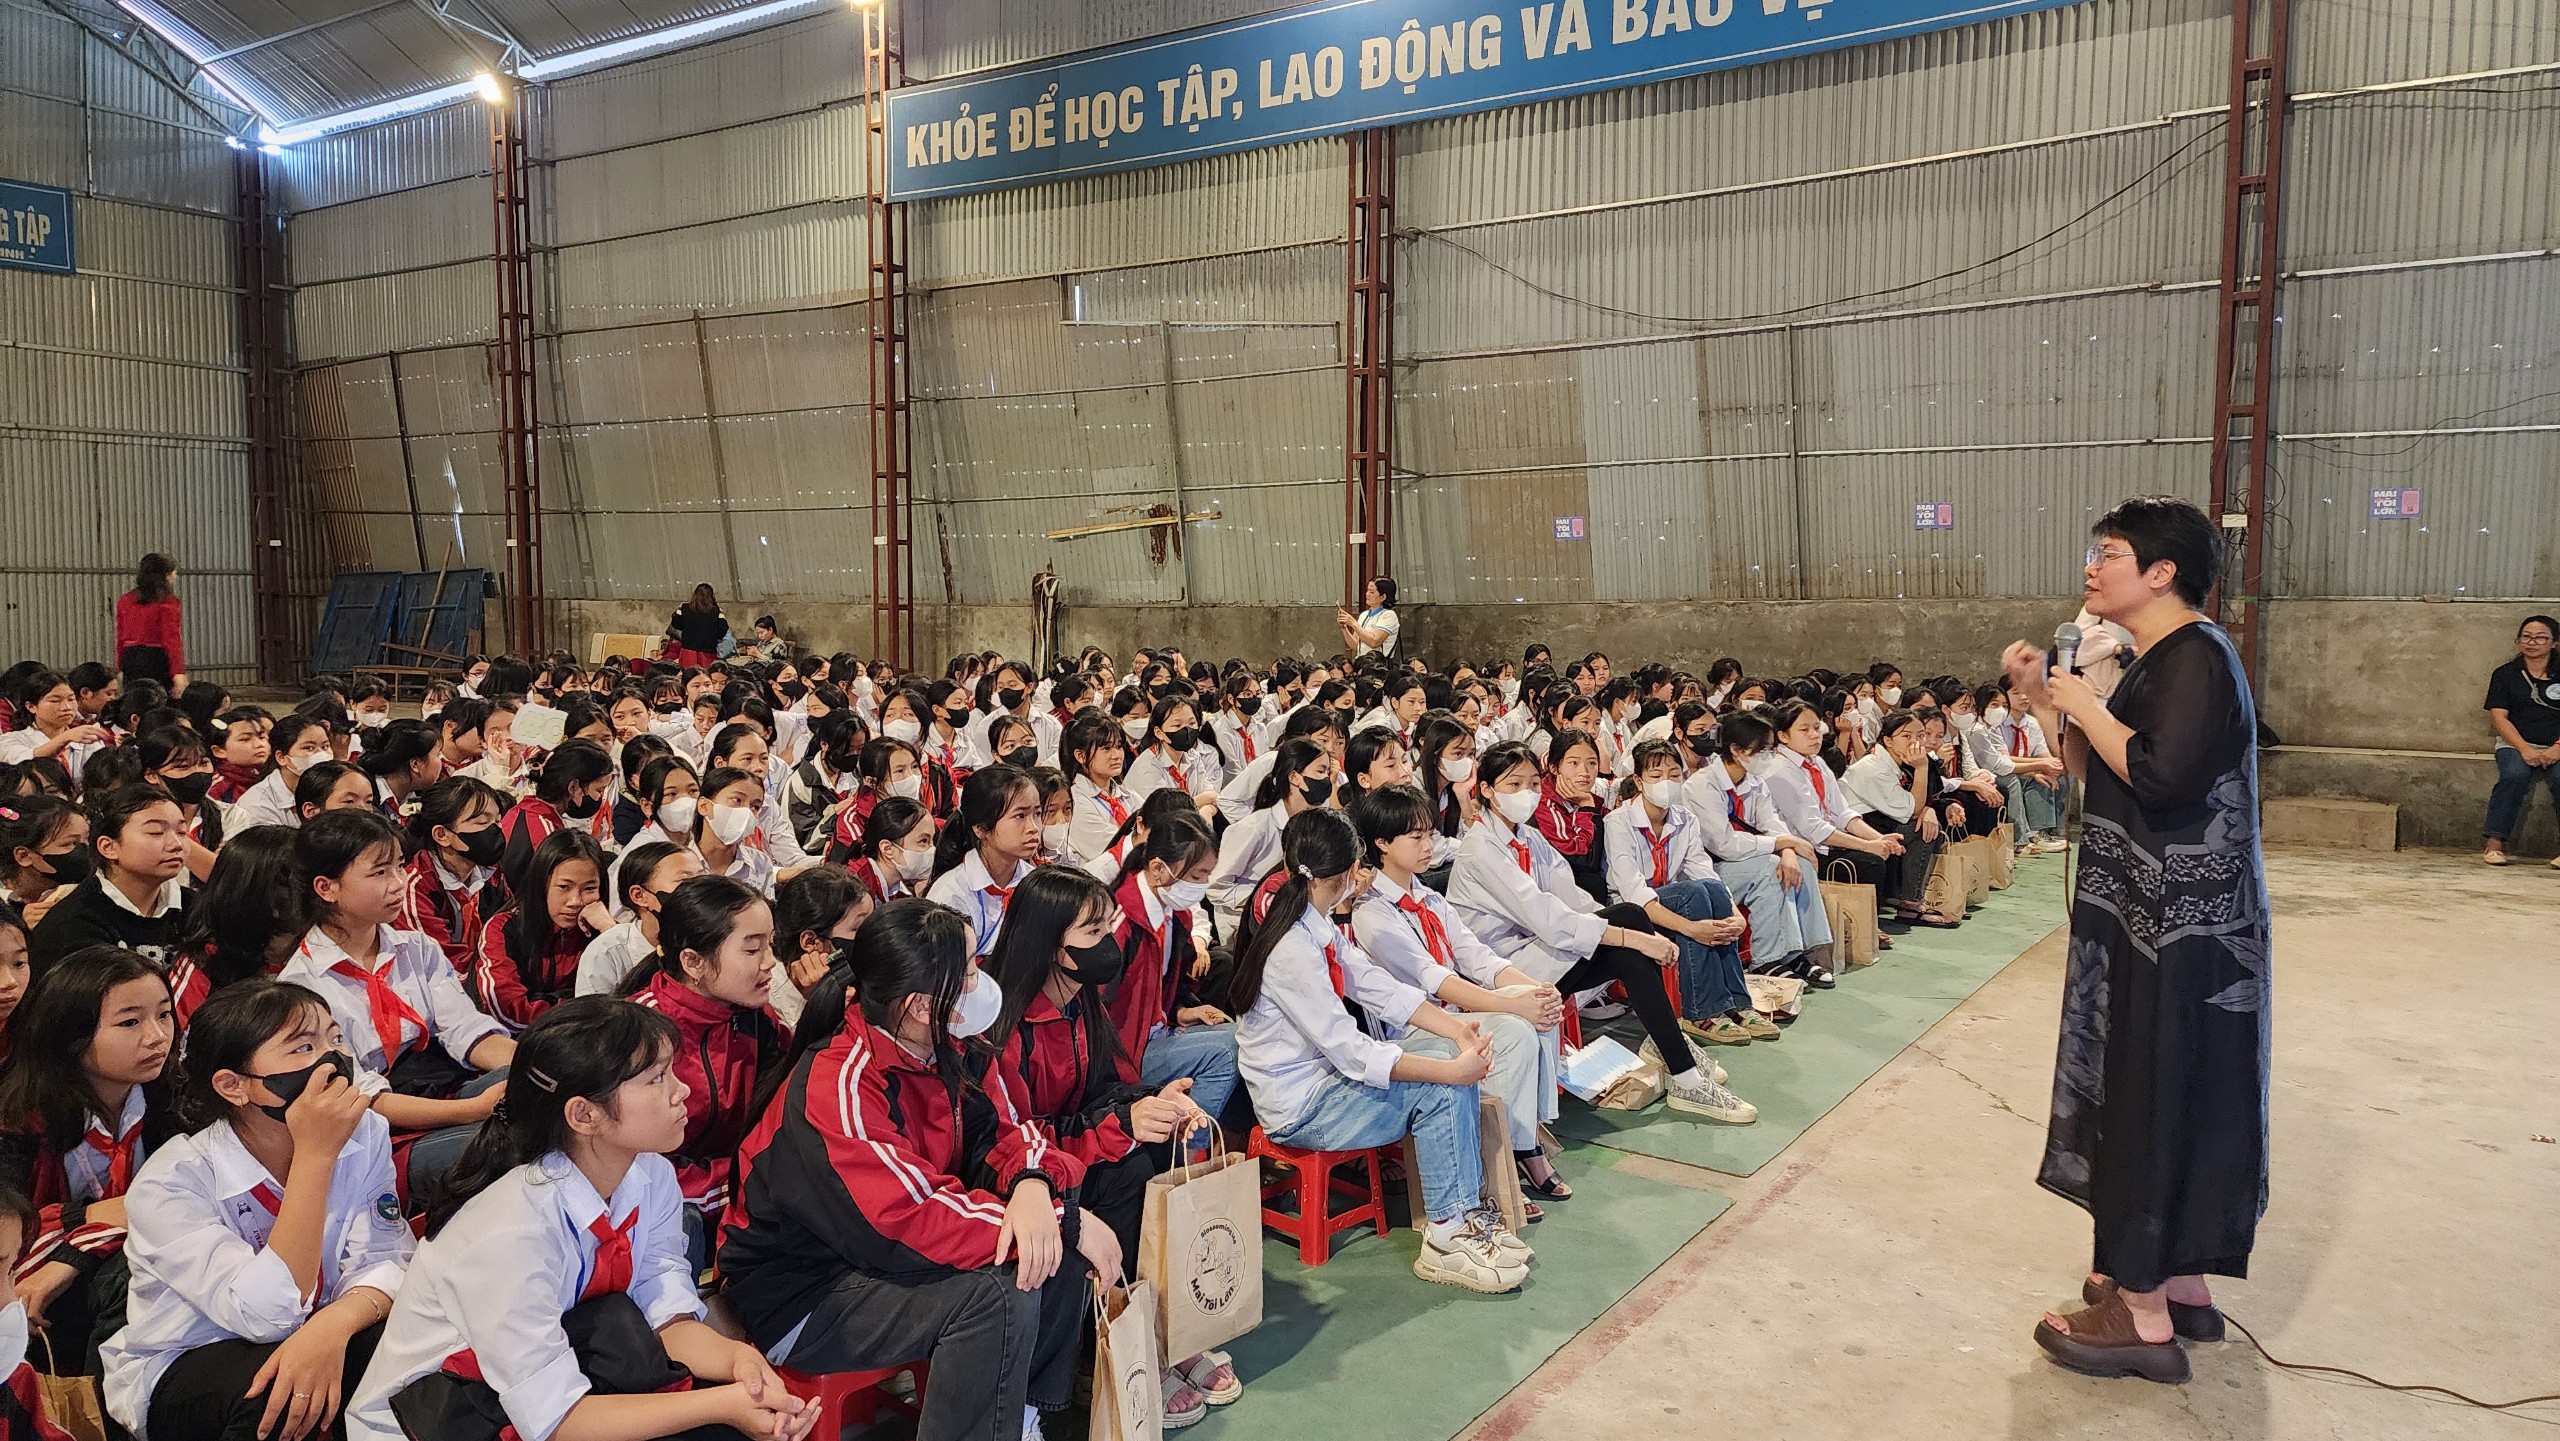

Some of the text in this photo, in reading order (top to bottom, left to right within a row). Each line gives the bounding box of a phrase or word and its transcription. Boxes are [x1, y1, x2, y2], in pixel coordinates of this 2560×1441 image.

[907, 102, 998, 168] KHỎE
[1009, 82, 1058, 153] ĐỂ
[1065, 85, 1144, 149] HỌC
[1157, 64, 1242, 133] TẬP,
[1258, 46, 1344, 108] LAO
[1360, 19, 1501, 95] ĐỘNG
[14, 205, 51, 253] TẬP
[2374, 490, 2398, 498] MAI
[1190, 1277, 1206, 1303] Mai
[1203, 1297, 1218, 1311] Tôi
